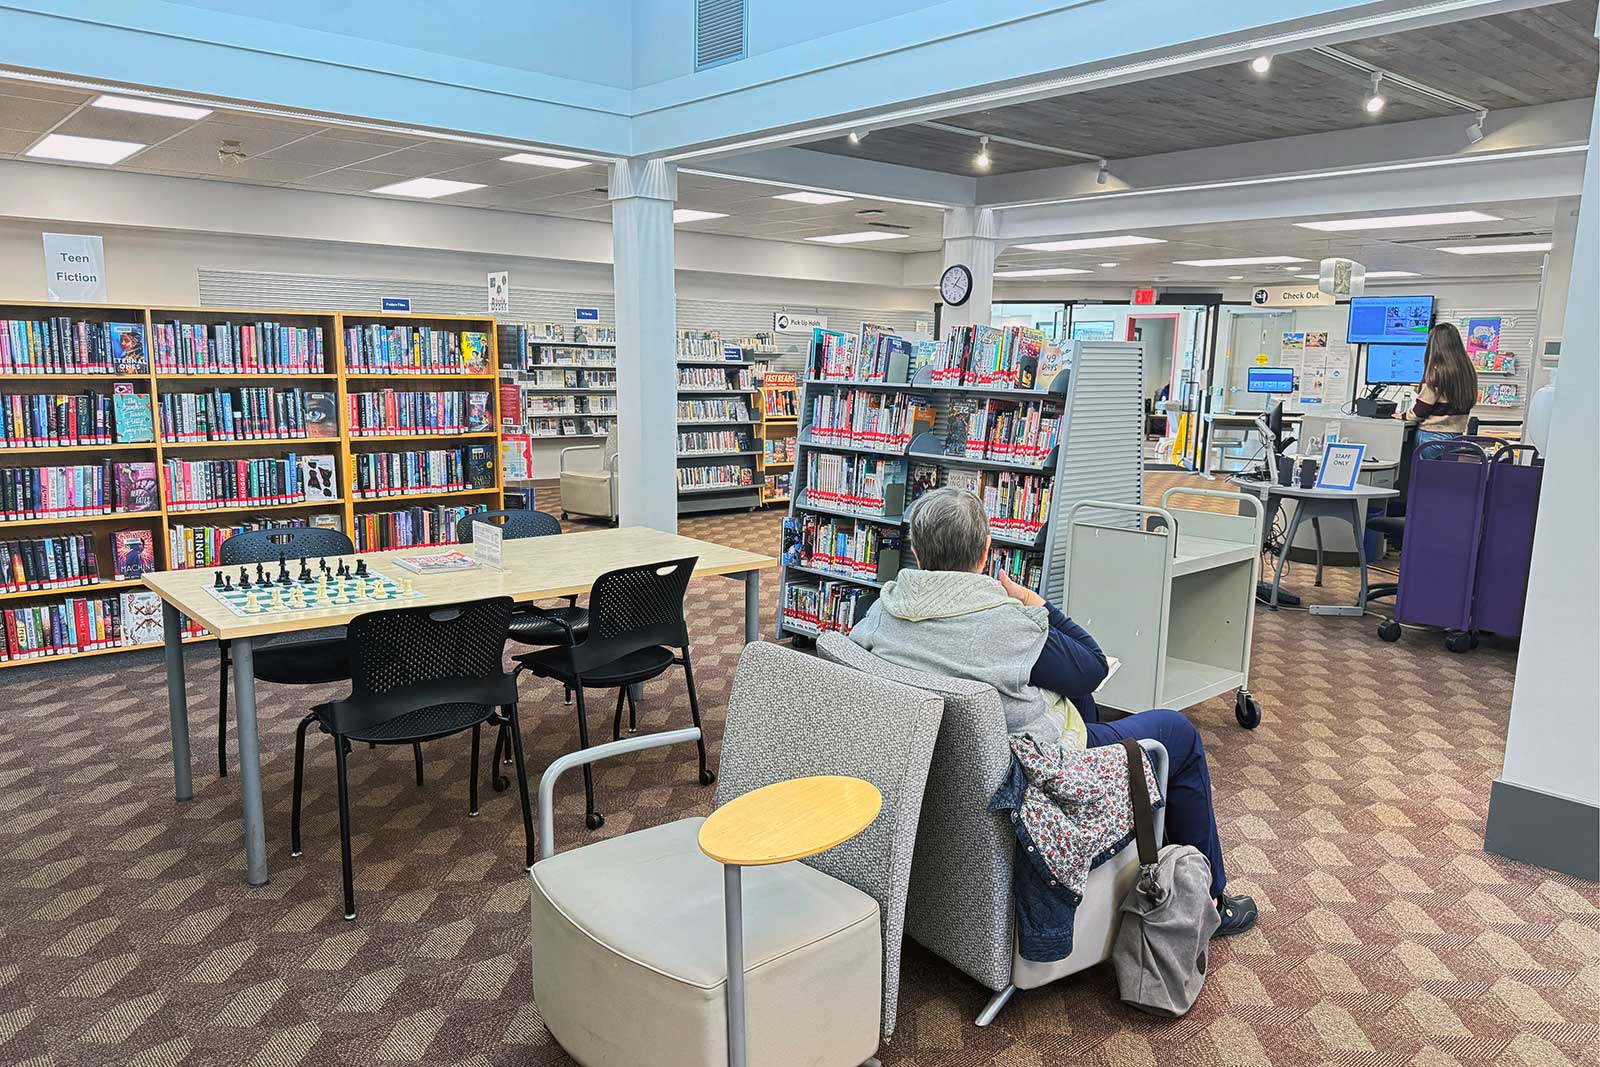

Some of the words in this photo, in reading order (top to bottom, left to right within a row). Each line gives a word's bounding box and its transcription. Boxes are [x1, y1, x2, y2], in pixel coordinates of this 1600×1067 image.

[60, 252, 90, 263] Teen
[56, 271, 97, 282] Fiction
[1135, 289, 1154, 305] EXIT
[1282, 291, 1305, 300] Check
[1305, 291, 1319, 299] Out
[801, 319, 808, 327] Up
[1046, 354, 1057, 363] 49
[1041, 362, 1058, 371] DAYS
[765, 374, 777, 383] FAST
[777, 374, 795, 383] READS
[472, 452, 492, 460] HEIR
[120, 563, 155, 573] MACHINE
